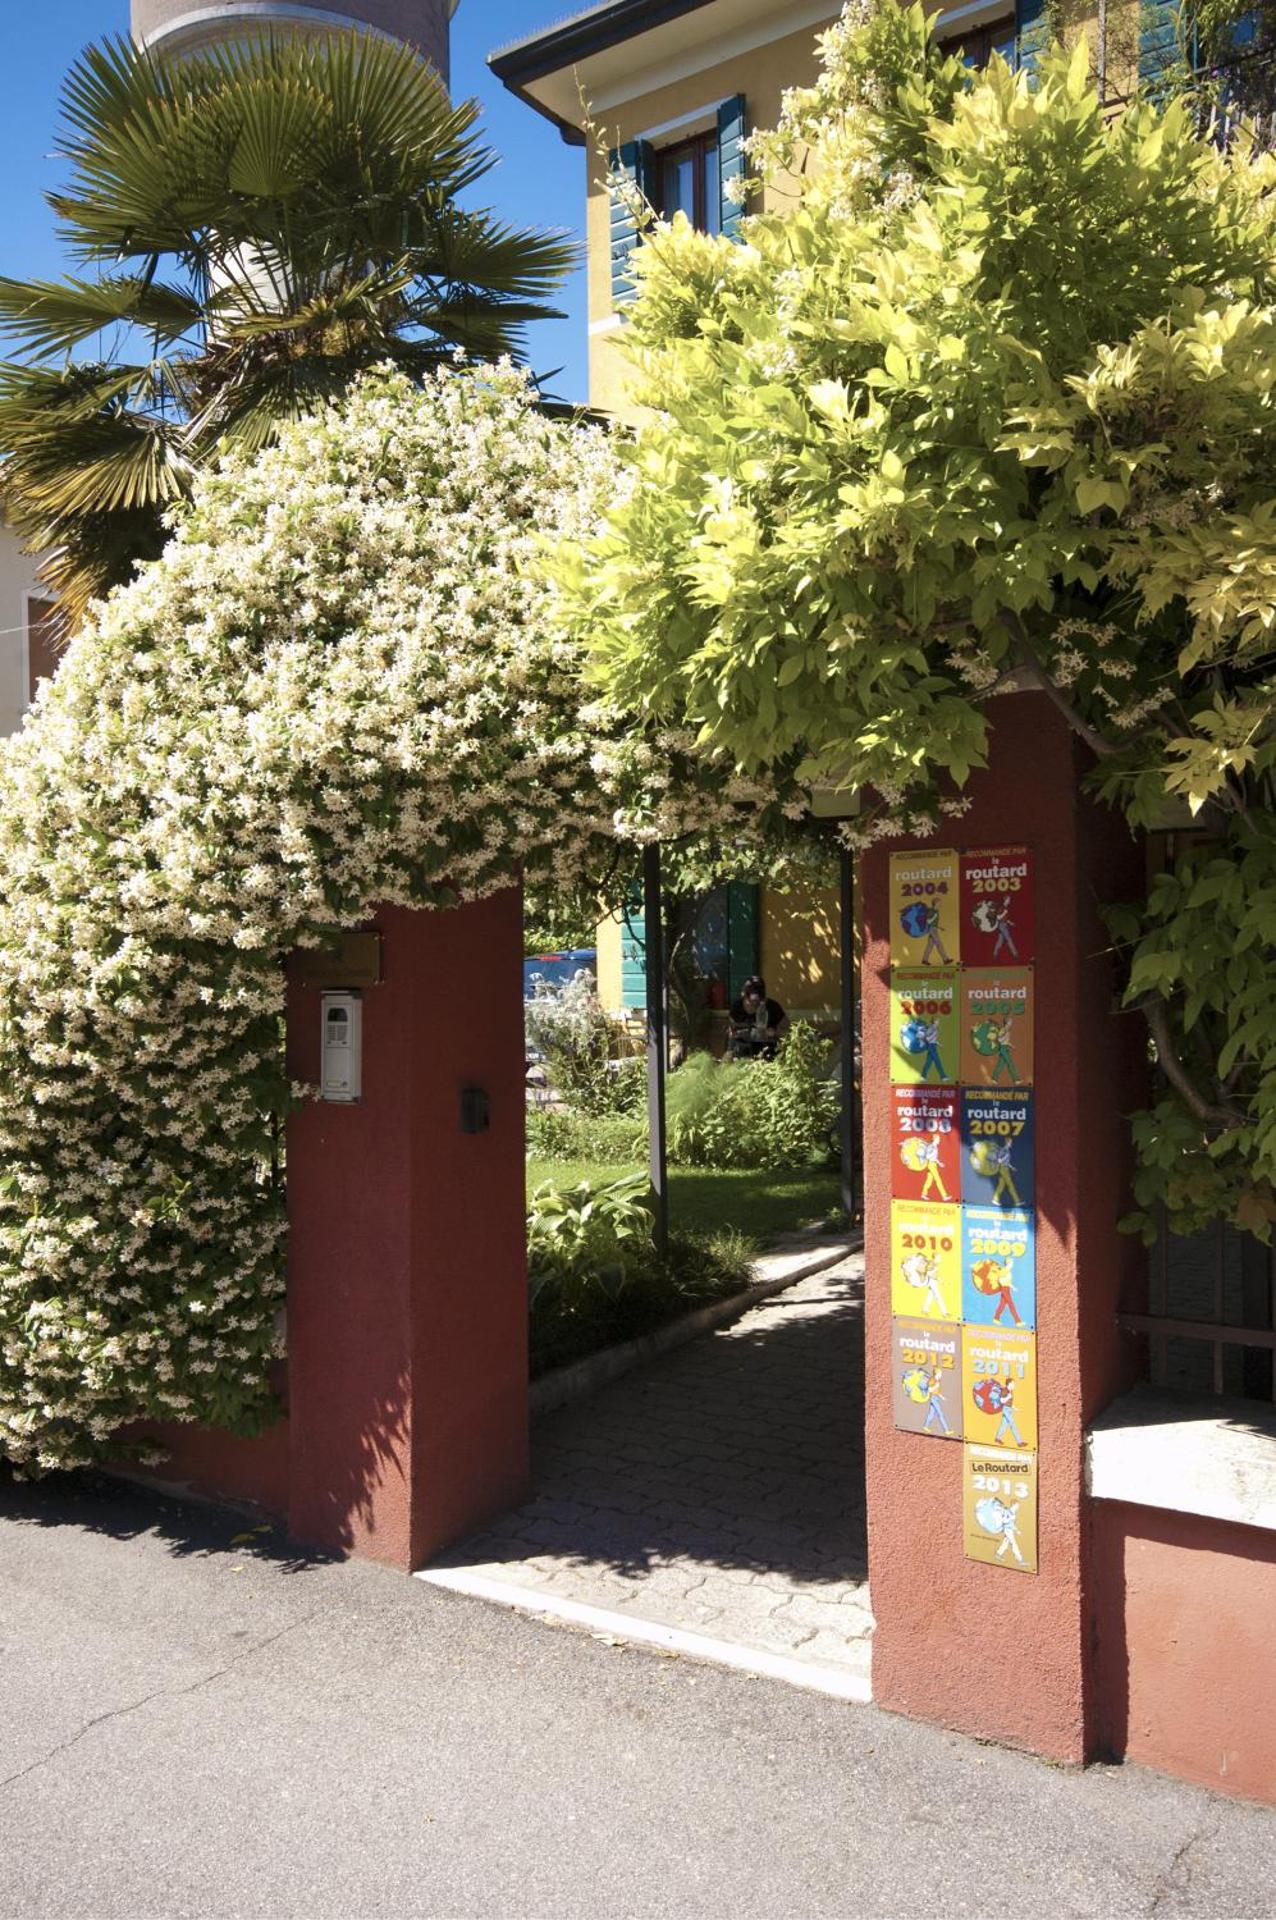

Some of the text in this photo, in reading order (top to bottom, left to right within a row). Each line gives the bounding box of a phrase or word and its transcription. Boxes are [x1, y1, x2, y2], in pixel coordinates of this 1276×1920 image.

[896, 866, 952, 881] routard
[966, 863, 1027, 880] routard
[901, 882, 948, 896] 2004
[972, 878, 1021, 893] 2003
[898, 986, 953, 999] routard
[968, 986, 1026, 999] routard
[901, 1001, 952, 1015] 2006
[971, 1001, 1025, 1016] 2005
[897, 1105, 953, 1118] routard
[968, 1107, 1026, 1120] routard
[900, 1117, 952, 1133] 2008
[970, 1120, 1025, 1136] 2007
[902, 1233, 953, 1251] 2010
[969, 1227, 1028, 1242] routard
[970, 1238, 1027, 1257] 2009
[899, 1337, 956, 1353] routard
[902, 1349, 955, 1369] 2012
[970, 1347, 1029, 1362] routard
[973, 1359, 1026, 1379] 2011
[972, 1474, 1029, 1498] 2013
